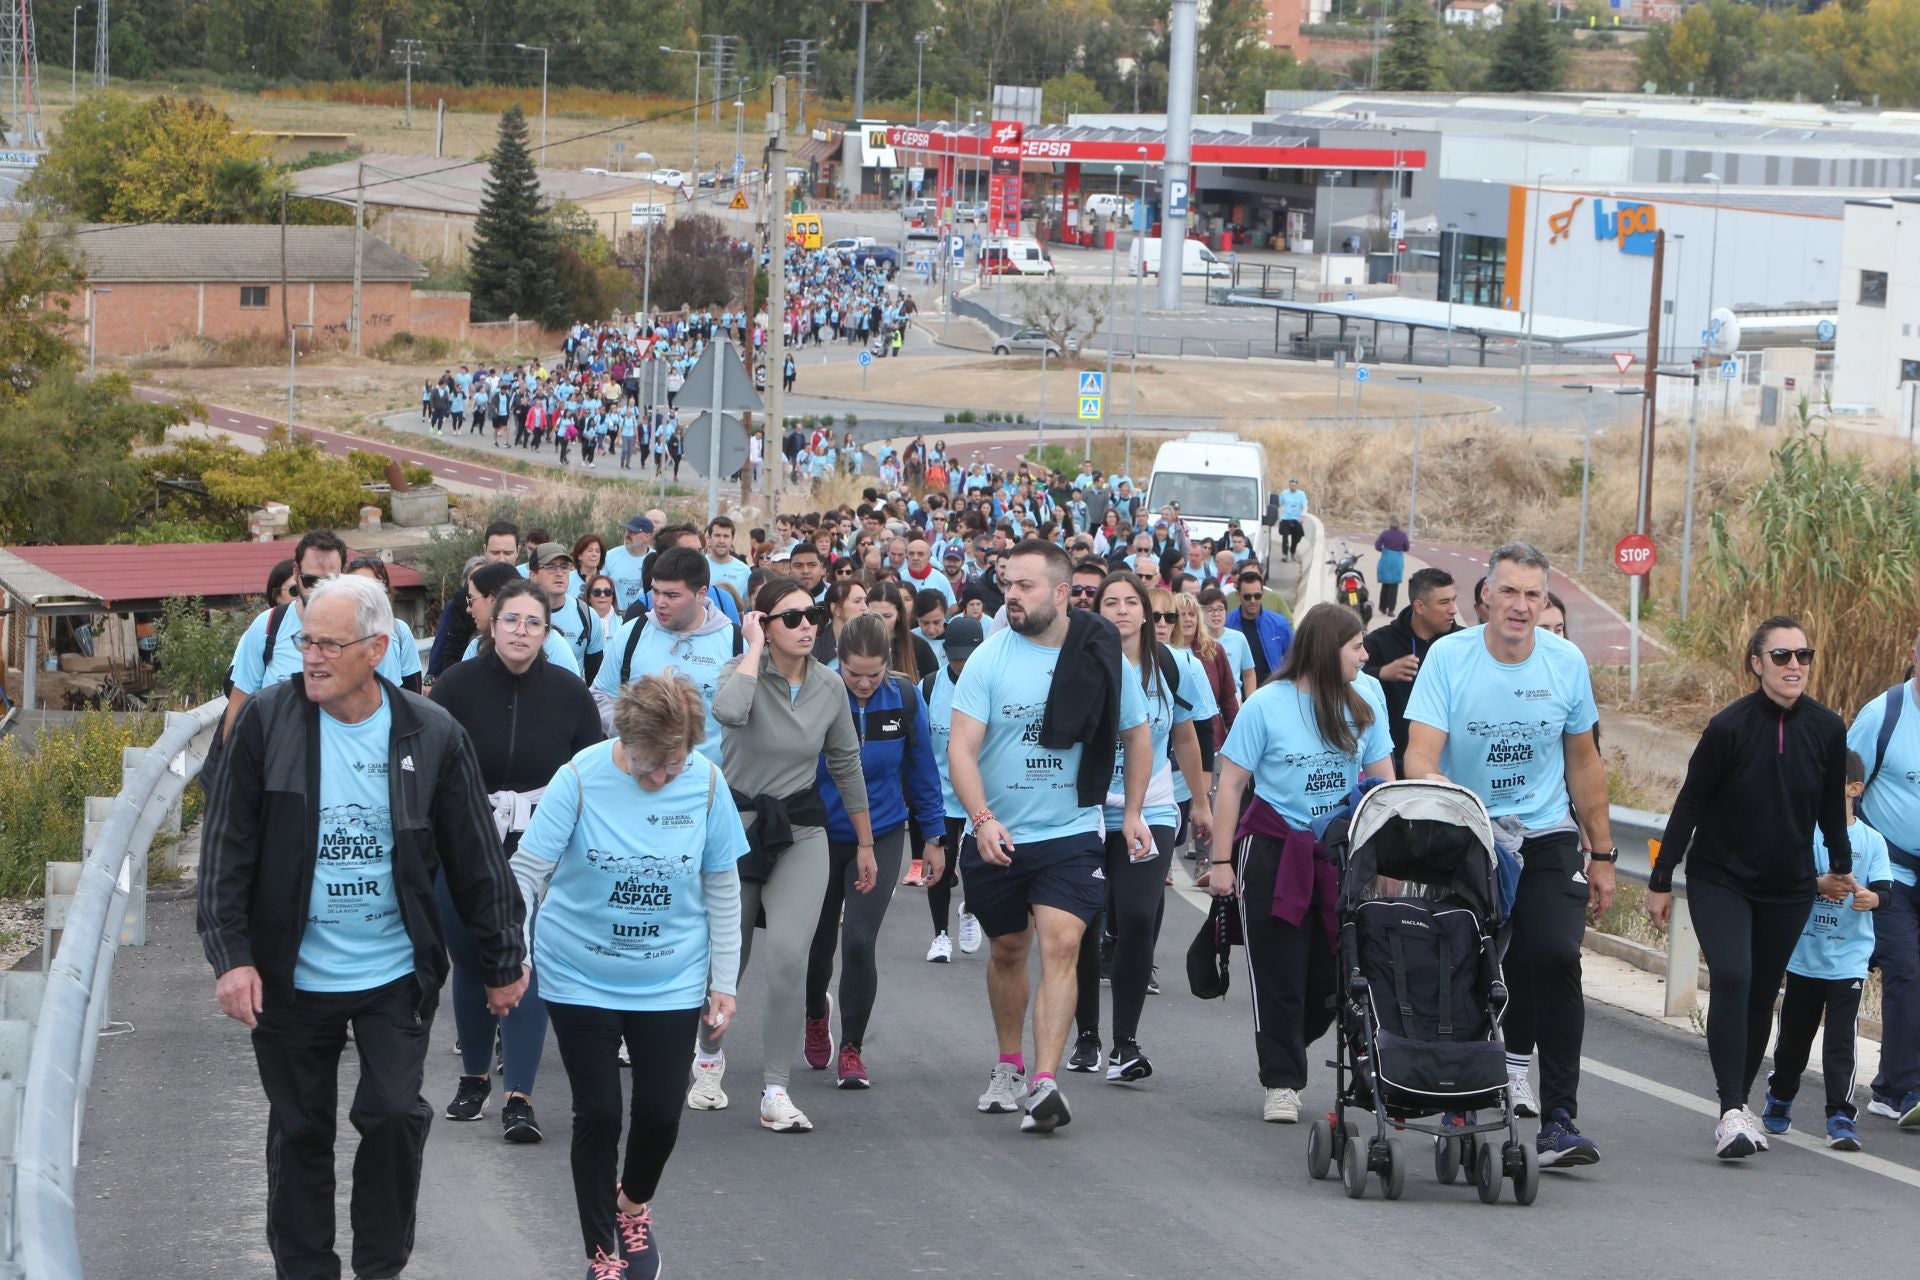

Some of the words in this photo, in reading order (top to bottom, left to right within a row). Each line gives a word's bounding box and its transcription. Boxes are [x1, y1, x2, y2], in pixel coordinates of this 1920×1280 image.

[901, 132, 929, 147] CEPSA
[992, 145, 1019, 154] CEPSA
[1171, 182, 1187, 206] P
[1594, 199, 1656, 249] lupa
[952, 236, 964, 256] P
[1620, 548, 1650, 562] STOP
[1491, 743, 1531, 752] Marcha
[1487, 751, 1533, 762] ASPACE
[1308, 771, 1343, 782] Marcha
[1305, 779, 1346, 792] ASPACE
[335, 827, 347, 835] 41
[323, 833, 377, 845] Marcha
[319, 845, 384, 860] ASPACE
[628, 875, 639, 884] 41
[615, 881, 668, 893] Marcha
[609, 891, 672, 906] ASPACE
[661, 948, 675, 956] Rioja
